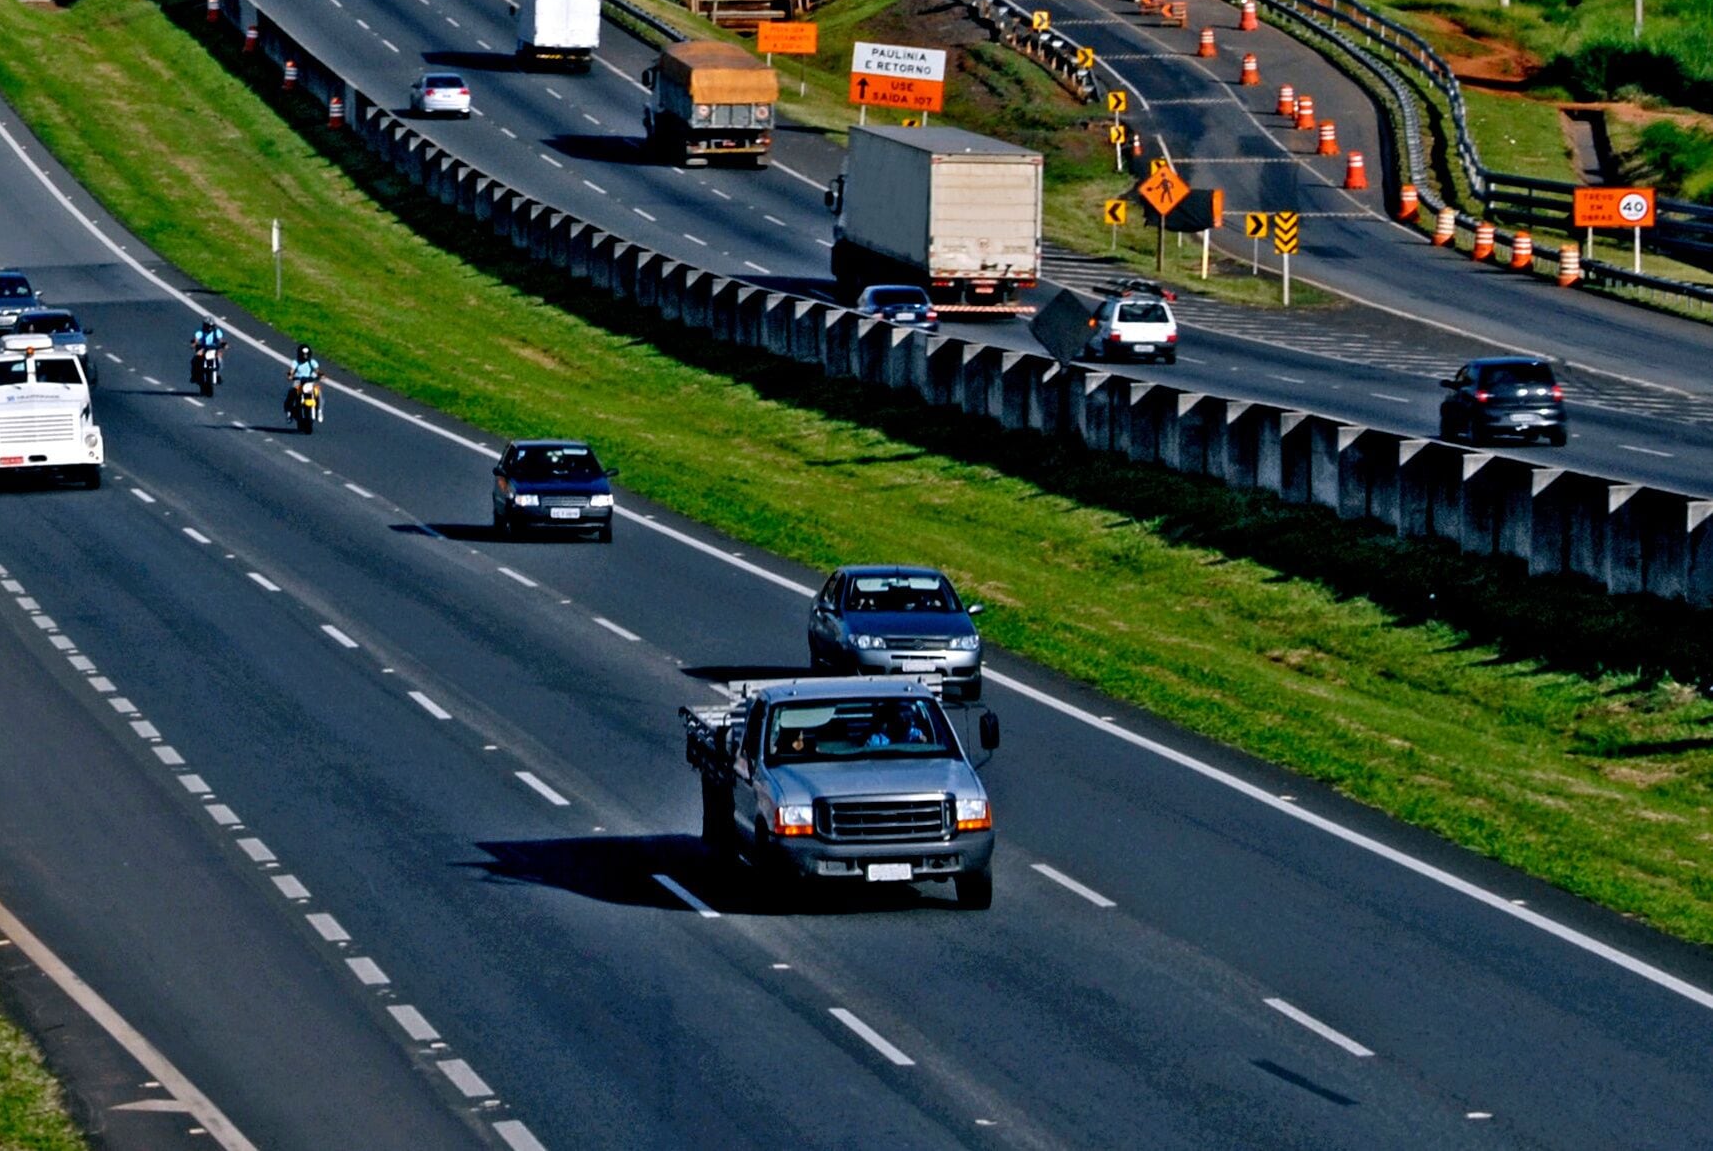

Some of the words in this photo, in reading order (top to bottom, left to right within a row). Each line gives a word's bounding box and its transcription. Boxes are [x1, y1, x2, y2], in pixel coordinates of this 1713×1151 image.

[865, 60, 872, 69] E
[877, 61, 931, 75] RETORNO
[891, 81, 914, 92] USE
[914, 96, 933, 106] 107
[1622, 201, 1644, 212] 40
